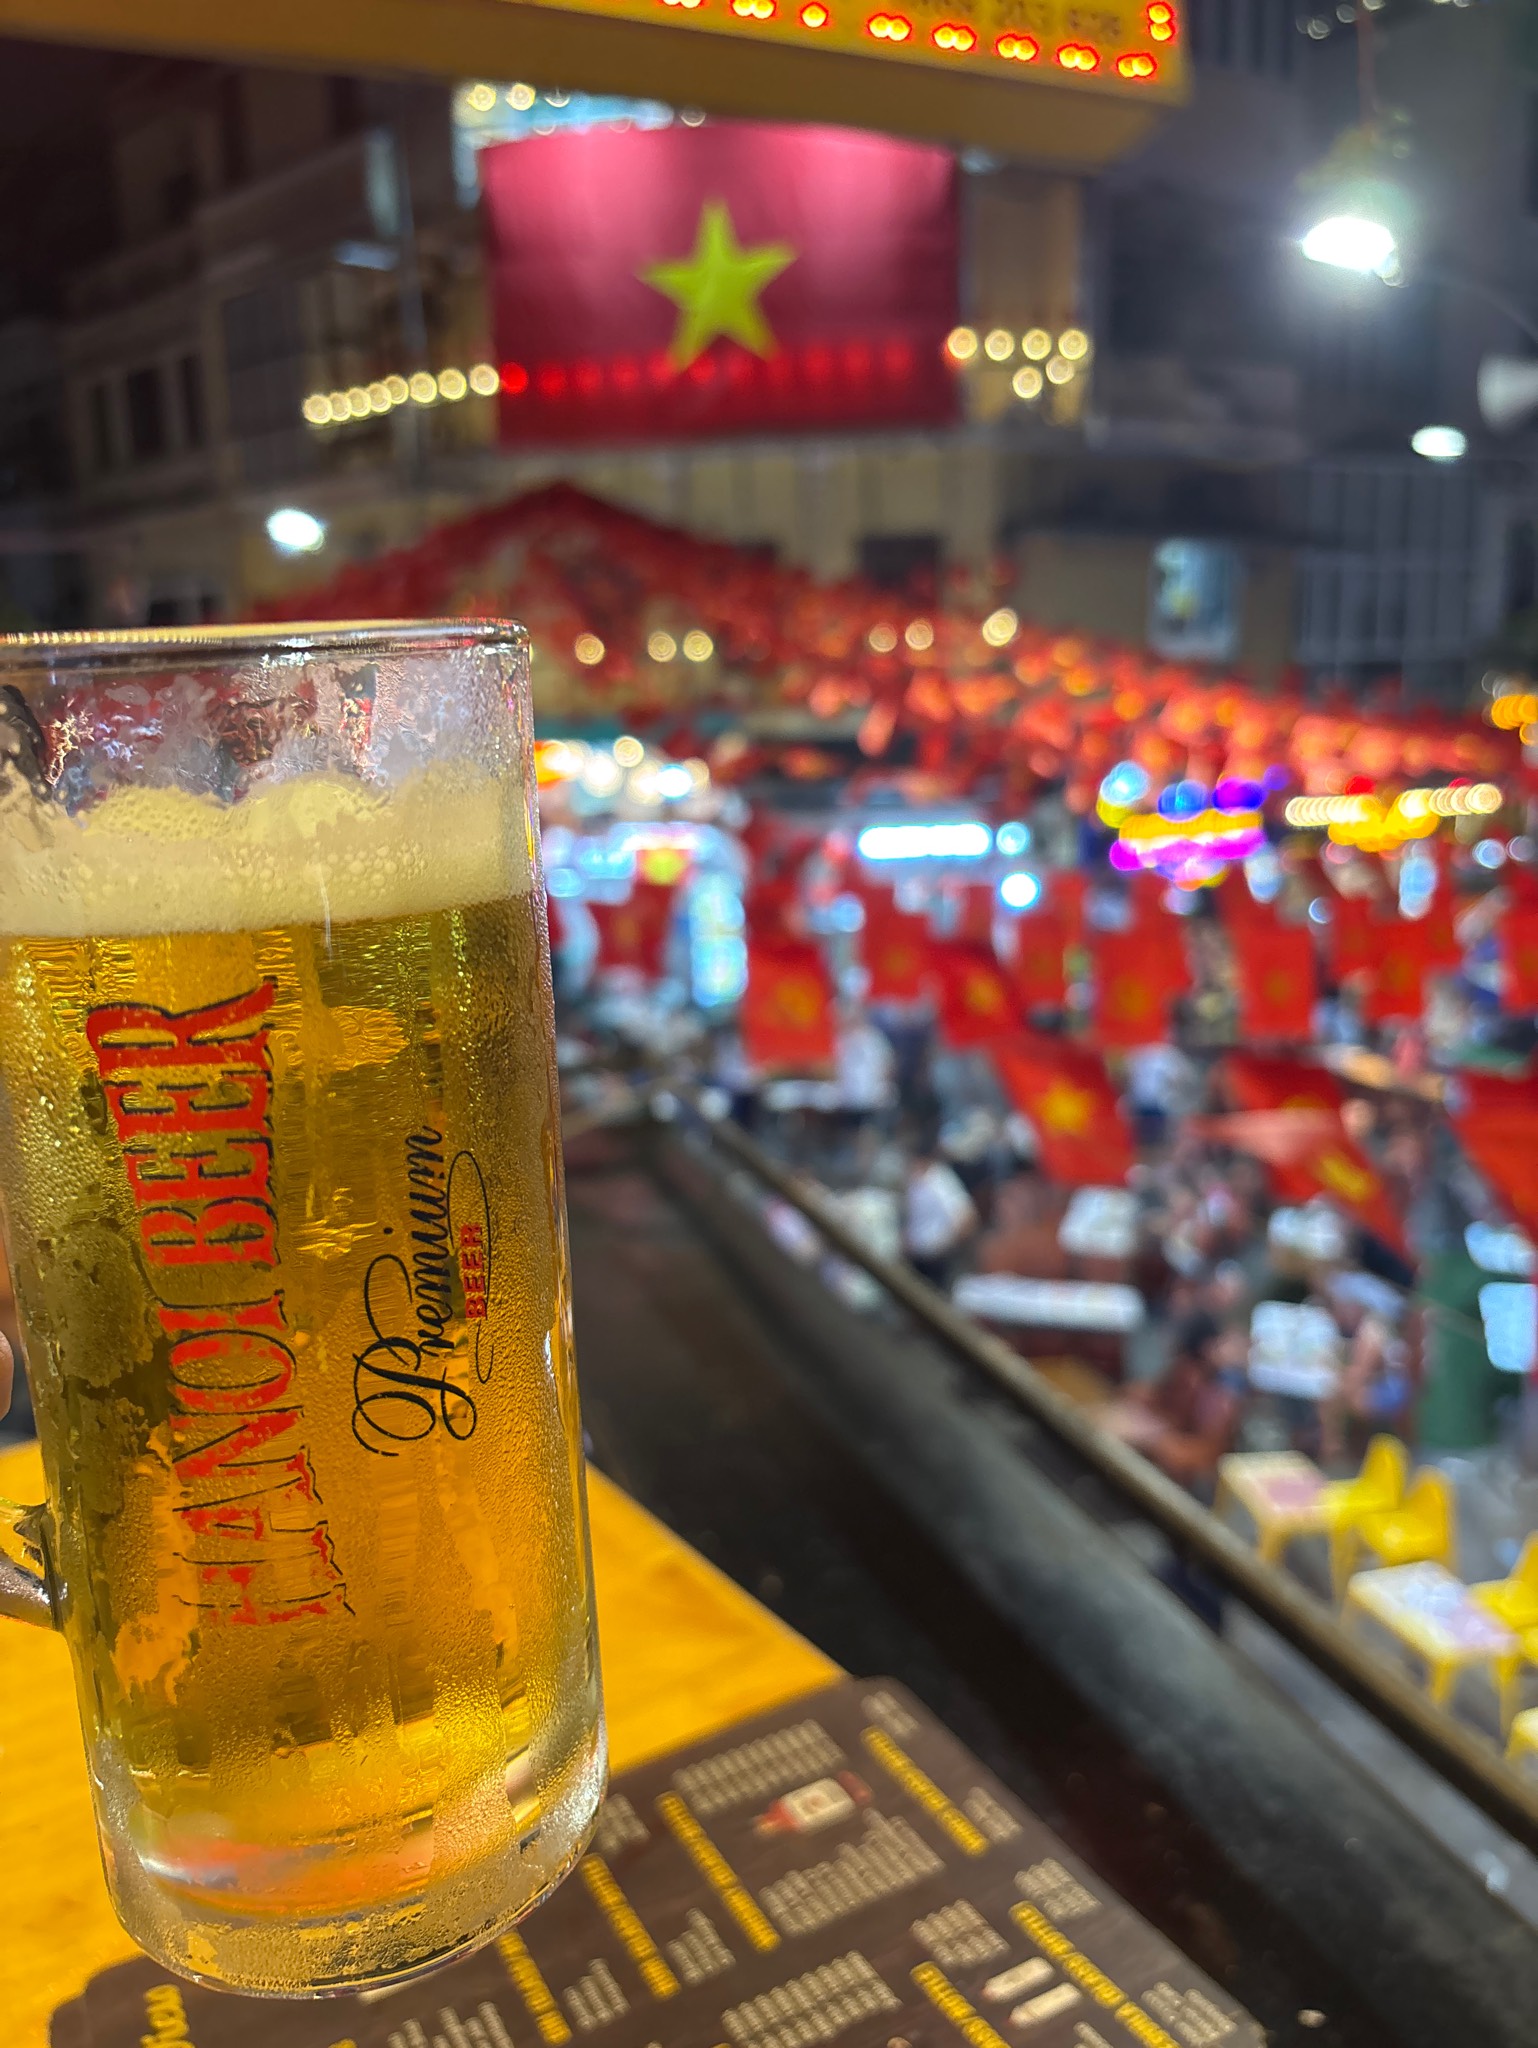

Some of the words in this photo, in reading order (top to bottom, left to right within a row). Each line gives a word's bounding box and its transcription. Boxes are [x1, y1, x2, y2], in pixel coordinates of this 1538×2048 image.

[86, 975, 280, 1271] BEER
[460, 1222, 487, 1319] BEER
[352, 1125, 477, 1456] Premium
[157, 1289, 355, 1626] HANOI
